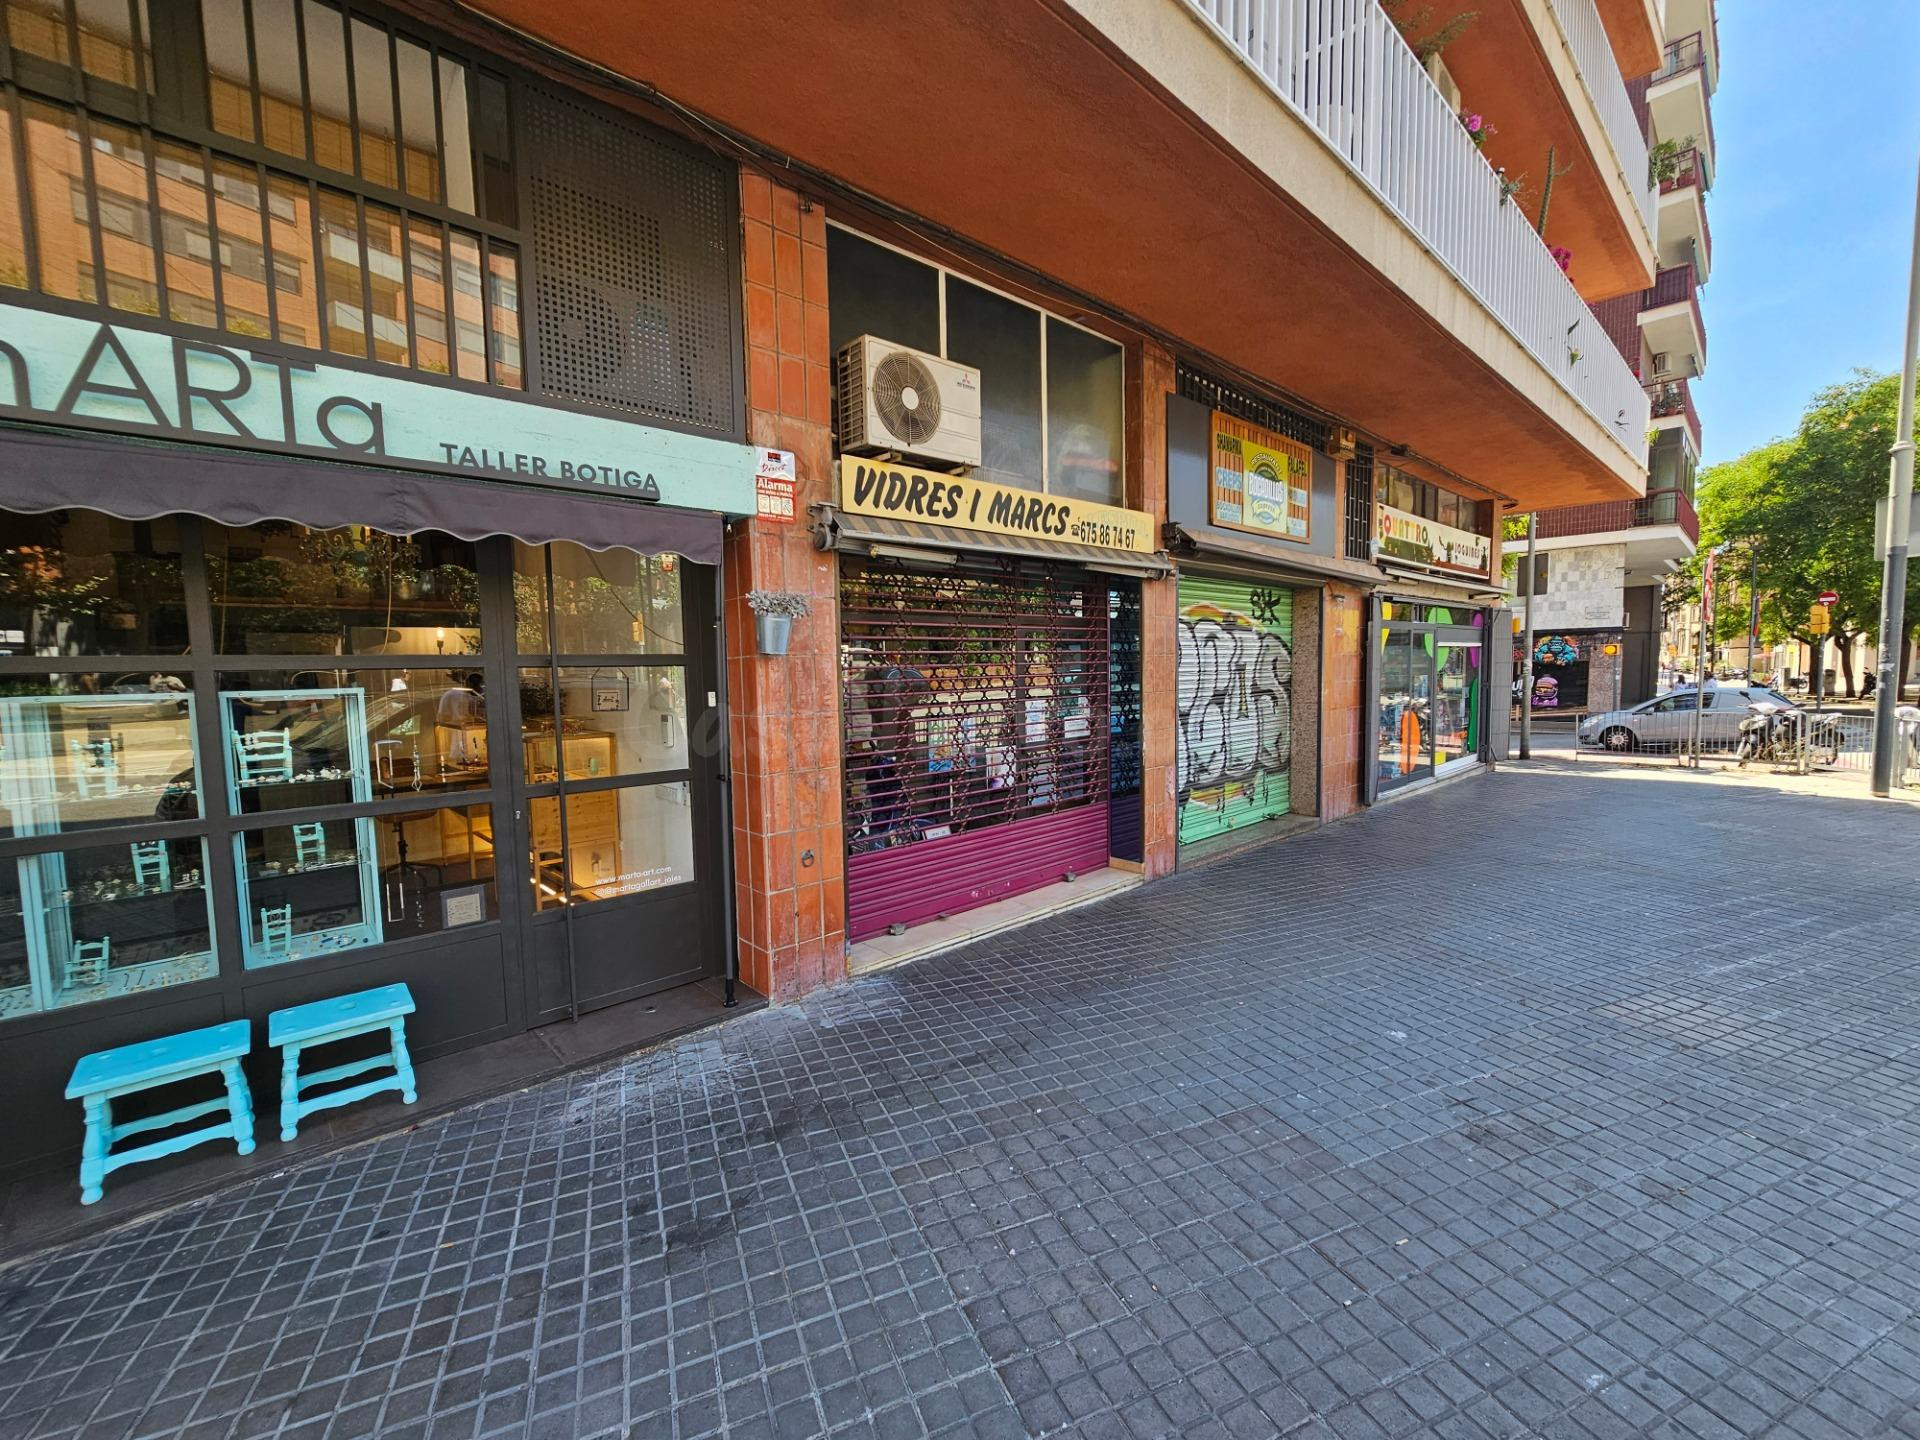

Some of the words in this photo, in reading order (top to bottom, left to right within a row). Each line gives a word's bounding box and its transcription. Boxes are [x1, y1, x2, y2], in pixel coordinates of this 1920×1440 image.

[439, 442, 550, 477] TALLER
[560, 460, 660, 491] BOTIGA
[757, 478, 793, 492] Alarma
[1217, 469, 1242, 491] CREPS
[853, 465, 963, 519] VIDRES
[969, 488, 981, 522] I
[987, 490, 1070, 536] MARCS
[1080, 521, 1097, 544] 675
[1099, 523, 1110, 546] 86
[1112, 526, 1123, 548] 74
[1125, 529, 1135, 549] 67
[1454, 542, 1480, 560] JOGUINES
